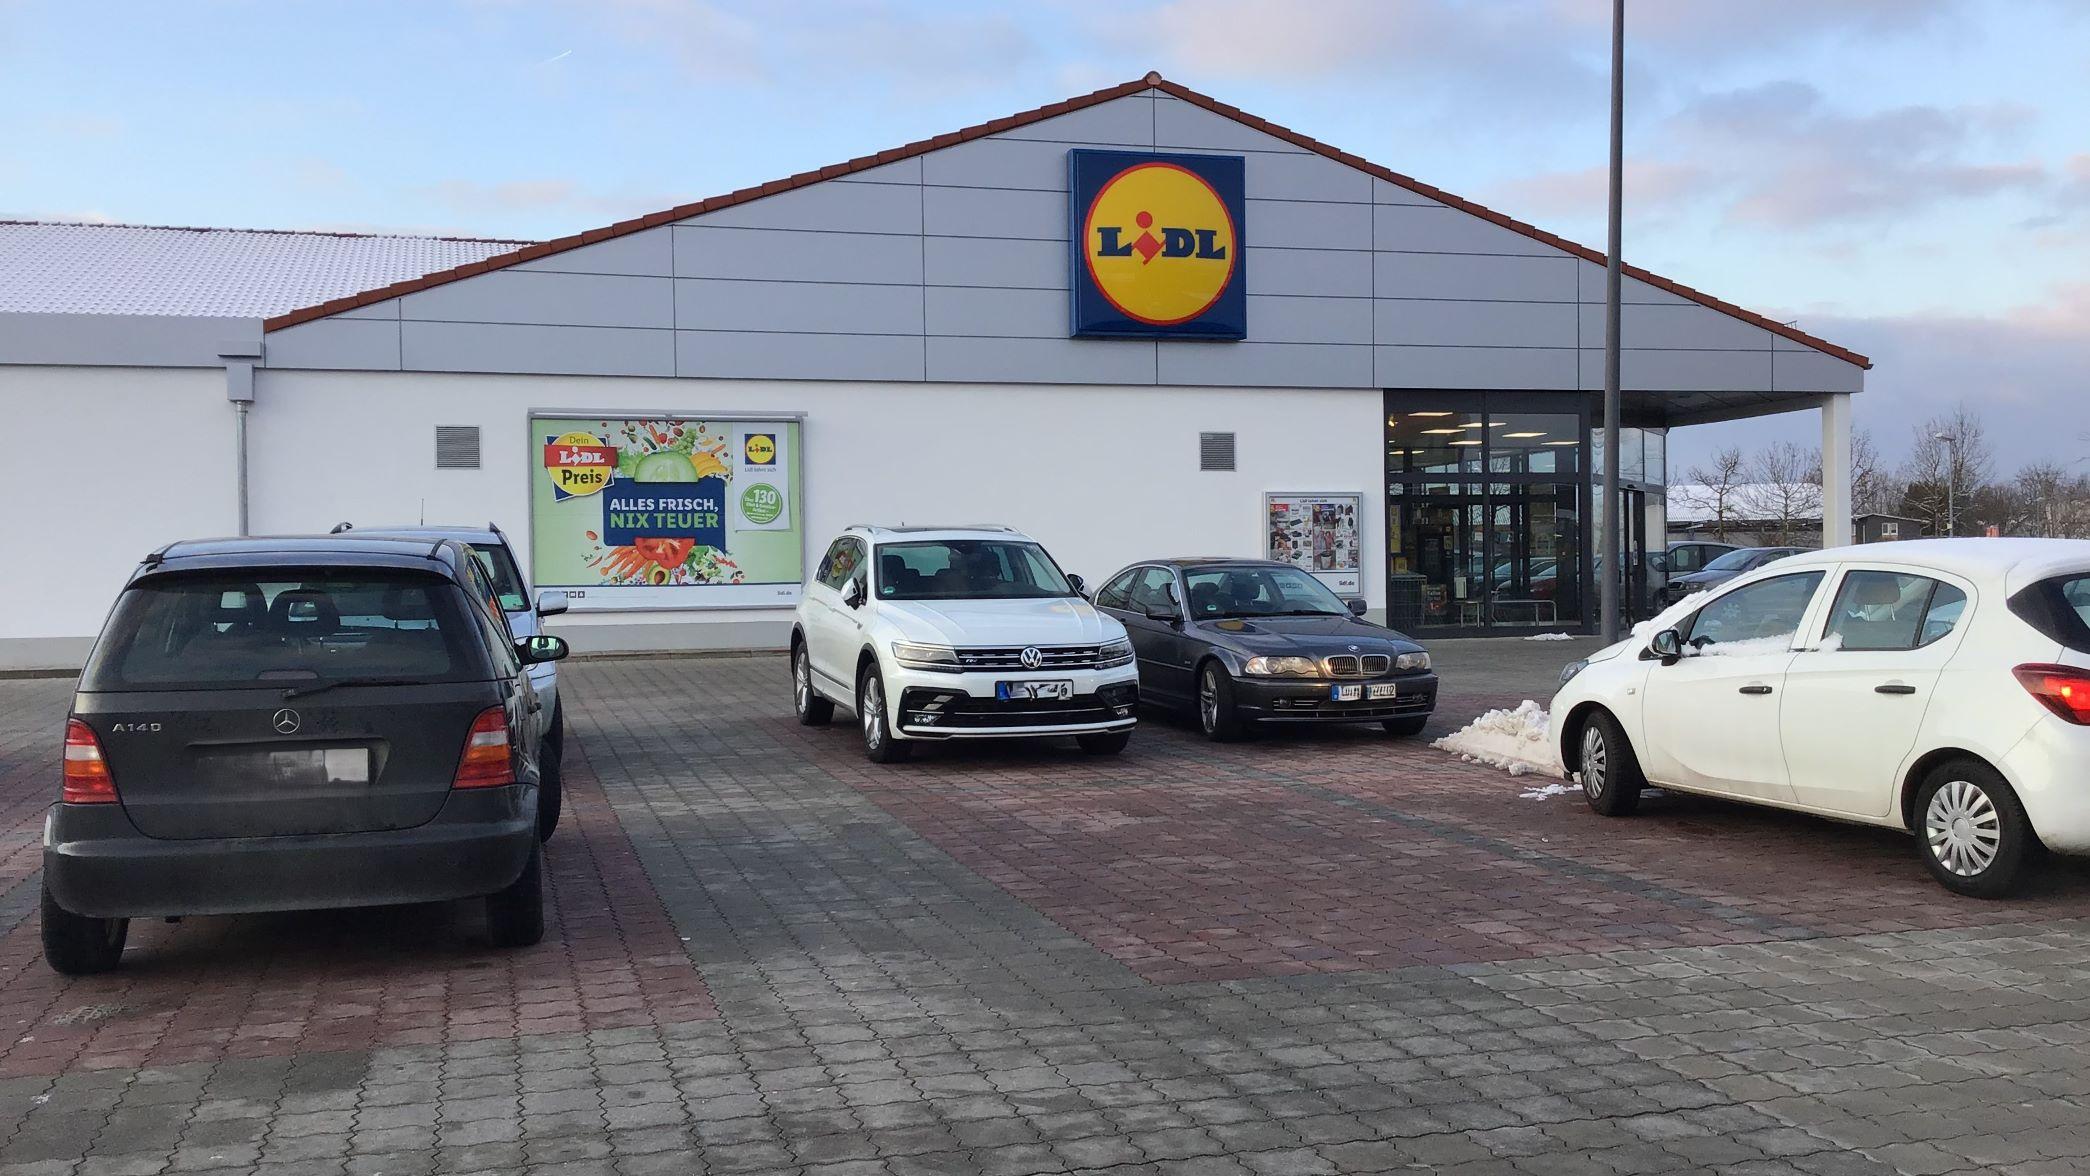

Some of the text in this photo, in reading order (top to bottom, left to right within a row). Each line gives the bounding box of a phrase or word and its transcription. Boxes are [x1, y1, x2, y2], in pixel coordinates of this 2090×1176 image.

[569, 436, 589, 444] Dein
[562, 469, 603, 485] Preis
[753, 489, 776, 505] 130
[610, 498, 719, 512] ALLES FRISCH,
[610, 513, 719, 529] NIX TEUER
[112, 723, 161, 732] A140
